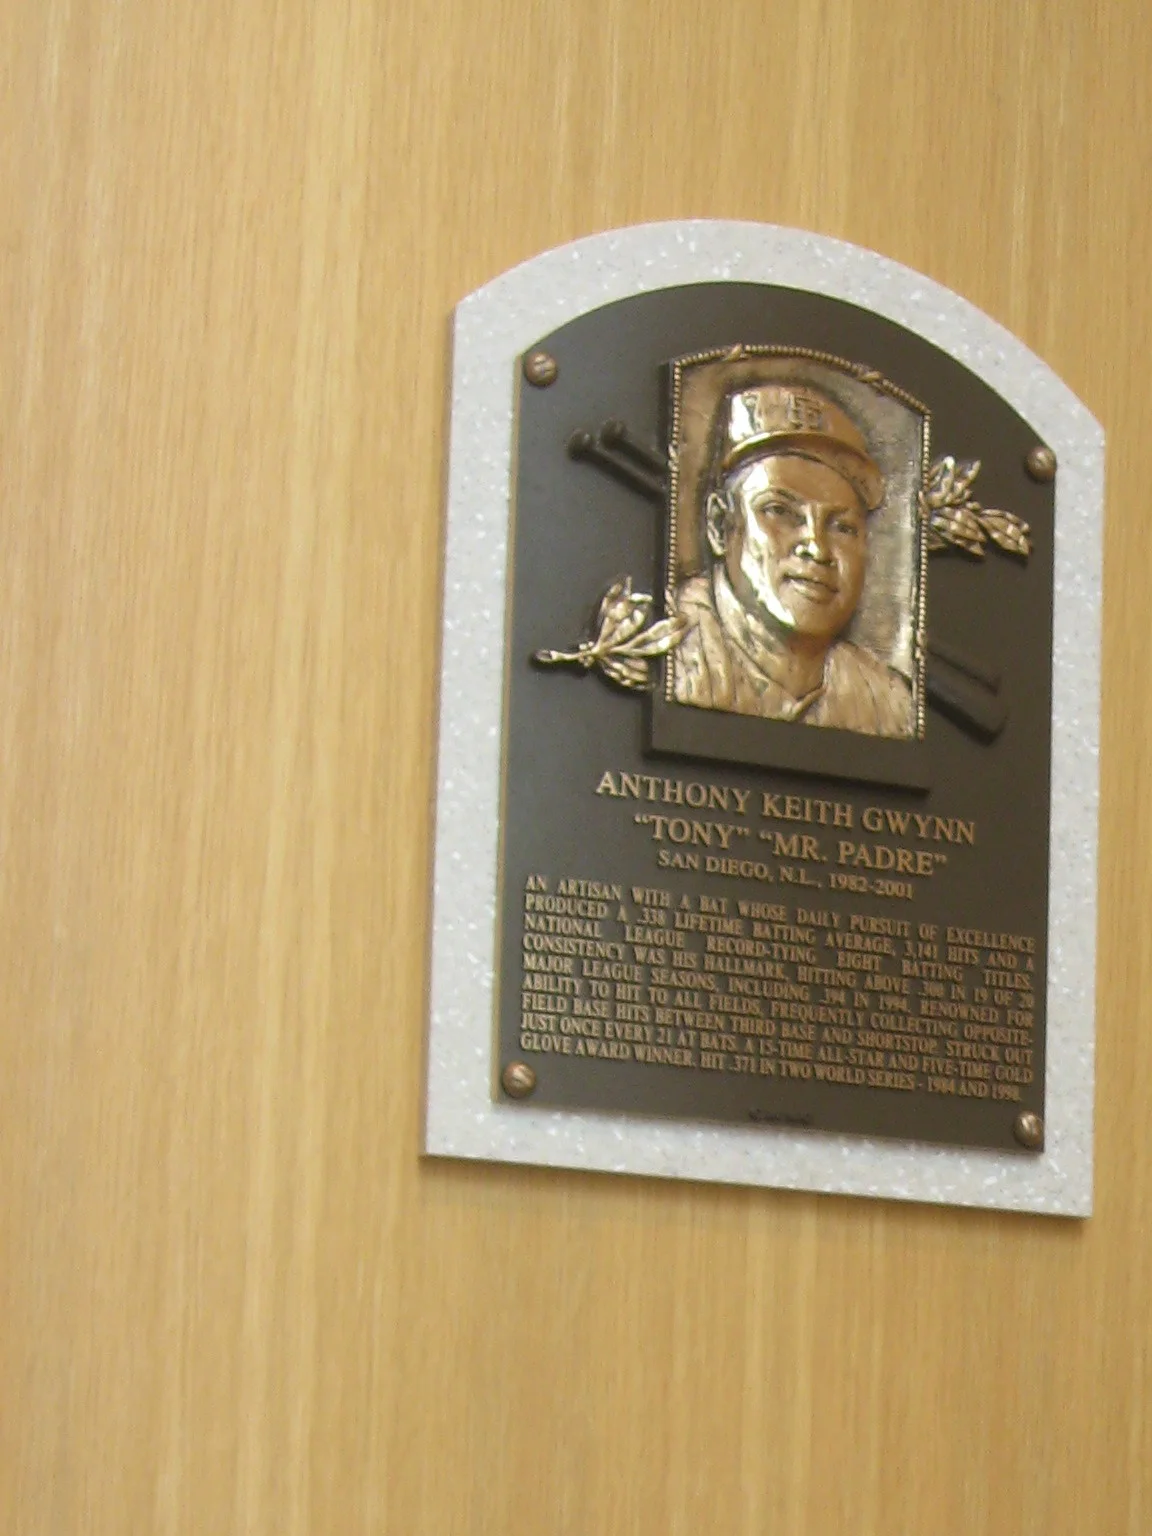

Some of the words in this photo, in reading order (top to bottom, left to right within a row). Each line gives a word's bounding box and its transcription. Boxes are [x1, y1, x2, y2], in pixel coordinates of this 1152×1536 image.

[595, 770, 749, 815] ANTHONY
[761, 792, 853, 829] KEITH
[861, 805, 975, 845] GWYNN
[633, 812, 750, 853] "TONY"
[838, 839, 947, 878] PADRE"
[657, 848, 698, 871] SAN
[705, 855, 773, 881] DIEGO,
[779, 864, 822, 887] N.L.,
[828, 870, 914, 898] 1982-2001
[524, 894, 610, 922] PRODUCED
[617, 905, 628, 924] A
[674, 912, 743, 937] LIFETIME
[752, 921, 816, 946] BATTING
[947, 945, 979, 965] HITS
[988, 950, 1017, 970] AND
[1026, 954, 1034, 972] A
[524, 914, 604, 941] NATIONAL
[624, 925, 685, 950] LEAGUE
[706, 935, 817, 965] RECORD-TYING
[837, 951, 880, 973] EIGHT
[901, 958, 963, 982] BATTING
[525, 874, 548, 894] AN
[557, 878, 623, 903] ARTISAN
[631, 887, 671, 909] WITH
[680, 893, 691, 912] A
[699, 895, 727, 916] BAT
[737, 900, 787, 923] WHOSE
[796, 907, 839, 930] DAILY
[849, 914, 909, 938] PURSUIT
[918, 922, 935, 941] OF
[946, 925, 1034, 953] EXCELLENCE
[522, 933, 626, 963] CONSISTENCY
[633, 946, 666, 967] WAS
[672, 951, 698, 971] HIS
[797, 965, 857, 989] HITTING
[864, 973, 909, 995] ABOVE
[951, 983, 966, 1002] IN
[993, 988, 1012, 1007] OF
[522, 953, 575, 977] MAJOR
[581, 960, 643, 984] LEAGUE
[728, 977, 810, 1003] INCLUDING
[853, 991, 869, 1010] IN
[920, 999, 999, 1025] RENOWNED
[1006, 1009, 1033, 1028] FOR
[521, 993, 566, 1015] FIELD
[572, 998, 608, 1020] BASE
[615, 1003, 649, 1024] HITS
[655, 1007, 724, 1032] BETWEEN
[730, 1016, 775, 1038] THIRD
[779, 1021, 815, 1042] BASE
[821, 1026, 852, 1046] AND
[945, 1040, 999, 1062] STRUCK
[1004, 1046, 1033, 1066] OUT
[522, 973, 582, 997] ABILITY
[590, 981, 609, 1000] TO
[615, 983, 640, 1004] HIT
[648, 987, 668, 1007] TO
[674, 990, 700, 1010] ALL
[770, 1001, 864, 1029] FREQUENTLY
[870, 1012, 957, 1039] COLLECTING
[964, 1023, 1033, 1047] OPPOSITE-
[520, 1032, 571, 1055] GLOVE
[575, 1038, 631, 1062] AWARD
[700, 1051, 724, 1071] HIT
[759, 1058, 774, 1077] IN
[778, 1060, 810, 1080] TWO
[813, 1064, 865, 1086] WORLD
[867, 1069, 914, 1091] SERIES
[959, 1079, 987, 1099] AND
[521, 1012, 556, 1034] JUST
[560, 1017, 600, 1039] ONCE
[604, 1021, 651, 1044] EVERY
[678, 1029, 695, 1049] AT
[745, 1037, 753, 1055] A
[817, 1045, 884, 1069] ALL-STAR
[888, 1052, 918, 1073] AND
[922, 1056, 990, 1080] FIVE-TIME
[995, 1064, 1033, 1085] GOLD
